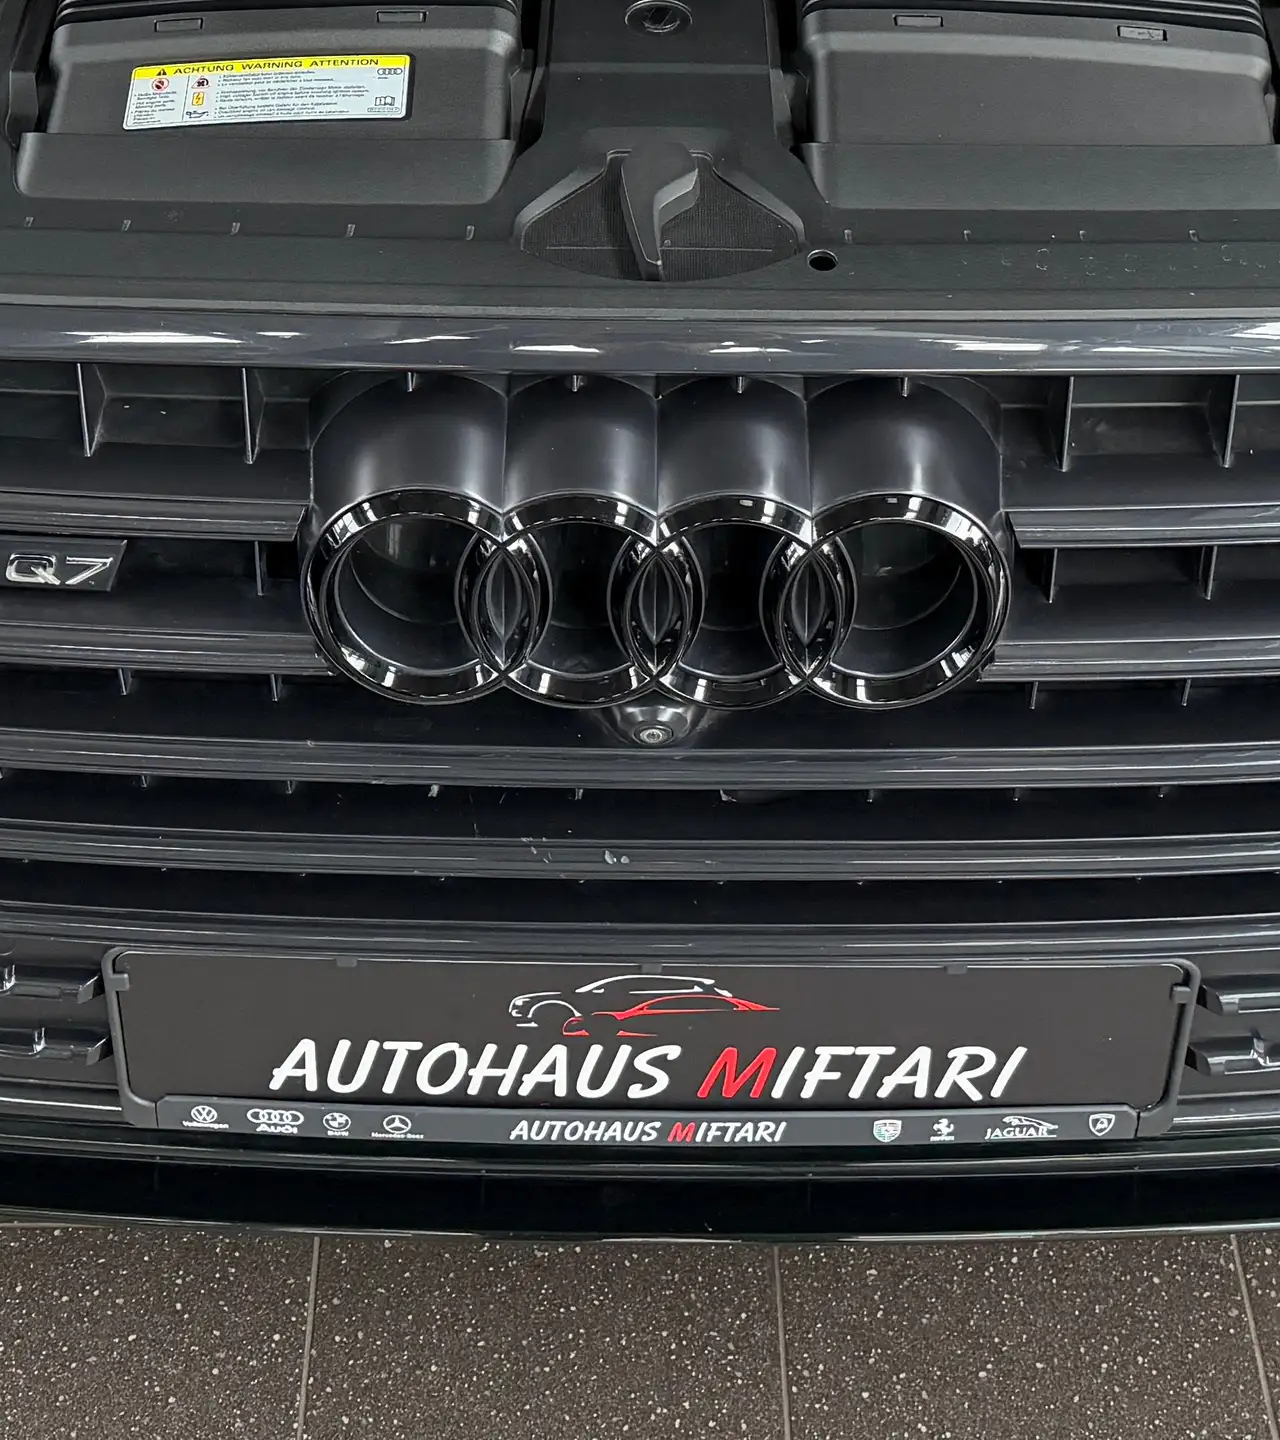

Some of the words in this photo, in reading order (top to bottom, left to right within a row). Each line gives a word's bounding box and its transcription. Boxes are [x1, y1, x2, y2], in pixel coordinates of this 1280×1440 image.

[173, 64, 234, 75] ACHTUNG
[241, 60, 303, 70] WARNING
[309, 58, 379, 67] ATTENTION
[269, 1038, 682, 1099] AUTOHAUS
[696, 1045, 1028, 1103] MIFTARI
[509, 1119, 662, 1142] AUTOHAUS
[667, 1121, 787, 1144] MIFTARI
[984, 1126, 1049, 1140] JAGUAR
